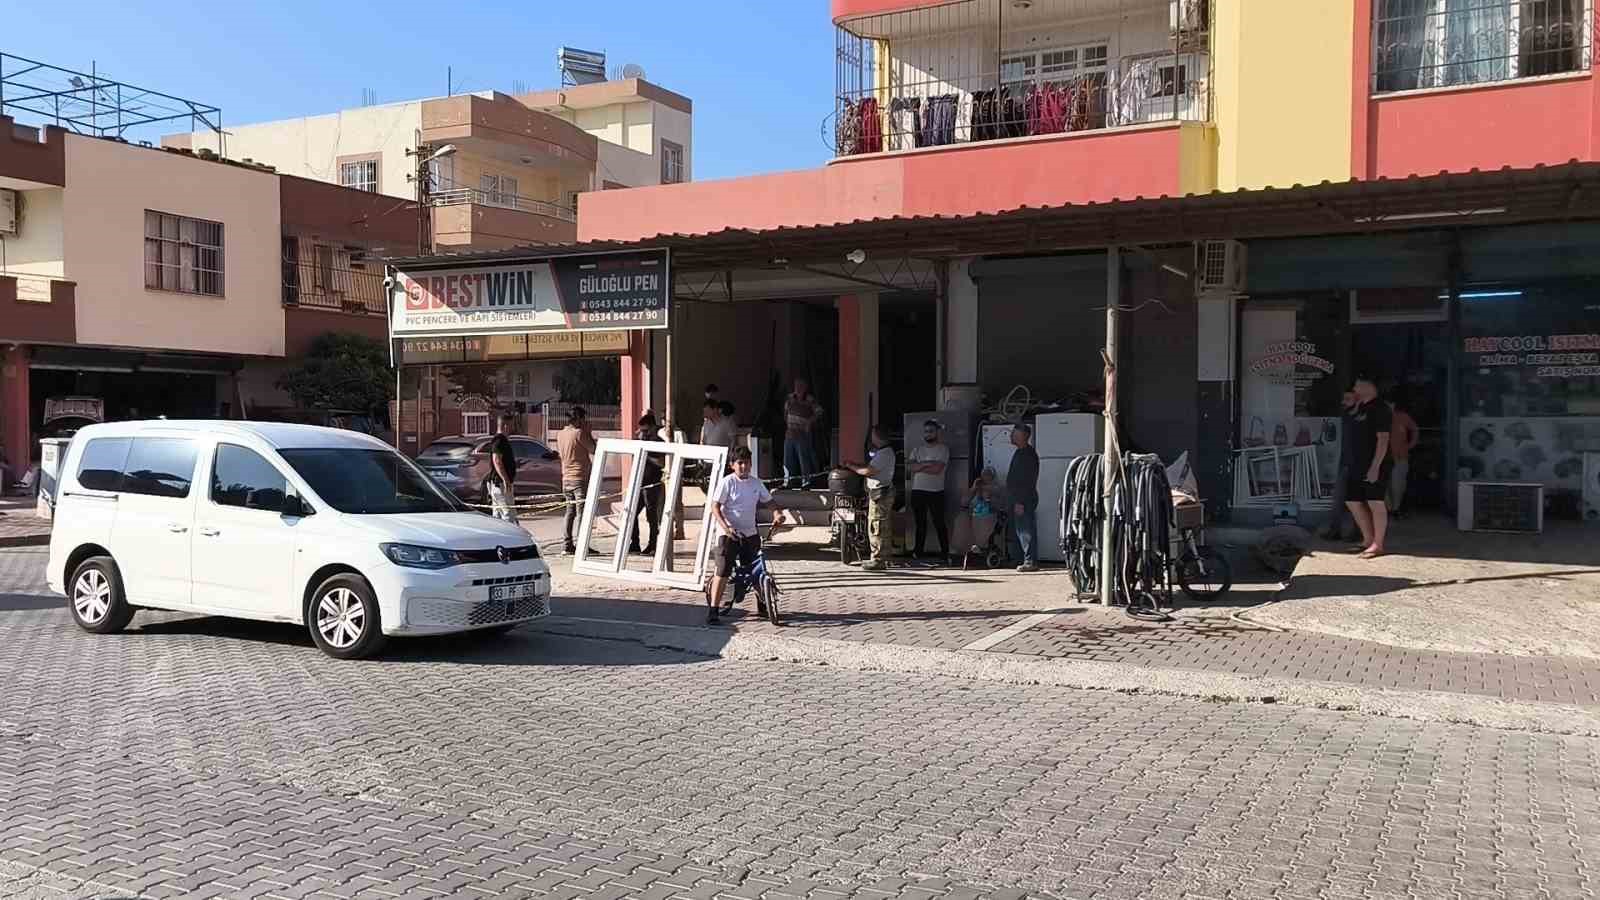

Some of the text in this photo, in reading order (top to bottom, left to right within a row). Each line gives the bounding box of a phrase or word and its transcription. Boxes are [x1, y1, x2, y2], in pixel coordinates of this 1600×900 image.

[580, 273, 658, 294] GÜLOĞLU PEN
[589, 298, 658, 309] 0543 844 27 90
[406, 316, 421, 325] PVC
[422, 314, 457, 325] PENCERE
[460, 313, 470, 323] VE
[589, 310, 658, 322] 0534 844 27 90
